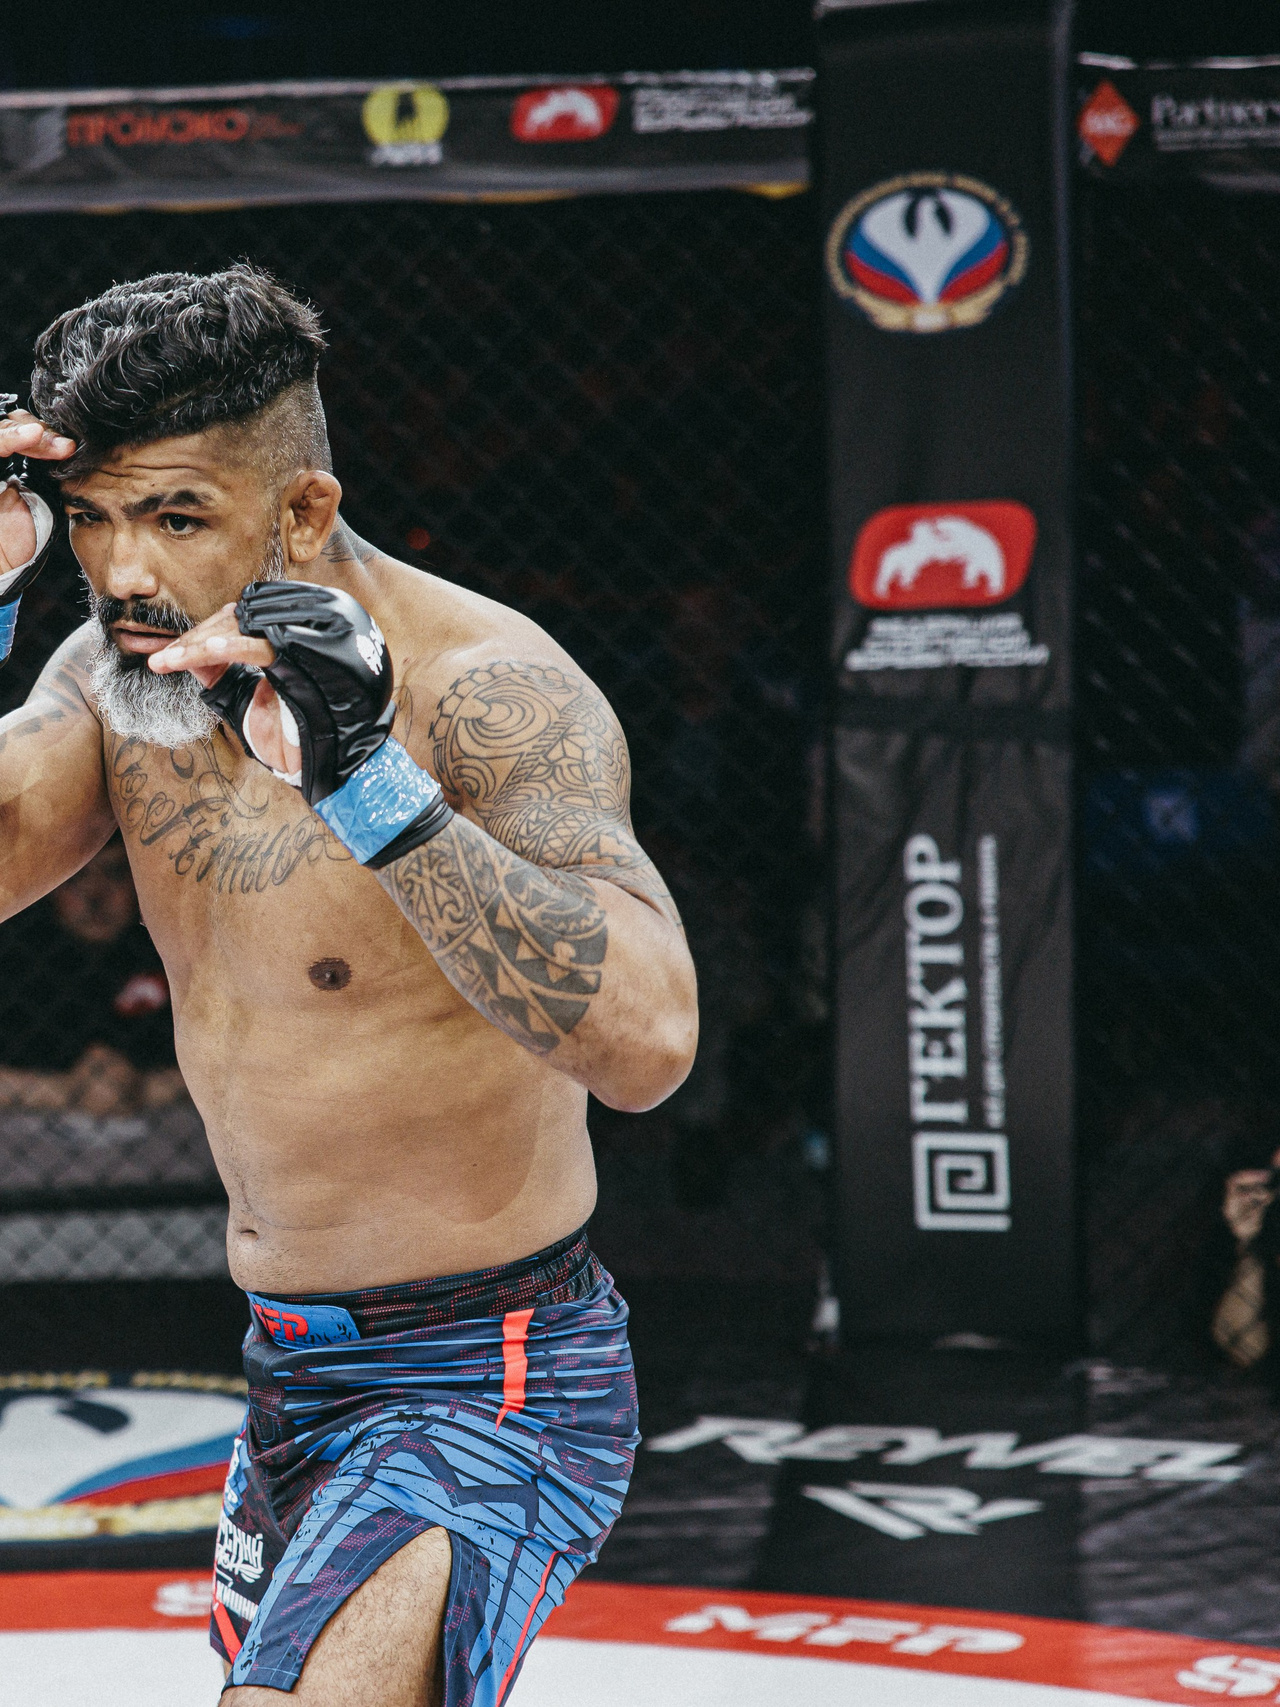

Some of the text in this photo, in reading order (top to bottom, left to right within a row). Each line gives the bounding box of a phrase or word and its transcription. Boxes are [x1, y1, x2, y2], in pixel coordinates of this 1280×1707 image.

[903, 833, 969, 1124] ГЕКТОР
[253, 1303, 309, 1342] FP
[664, 1604, 1024, 1656] MFP
